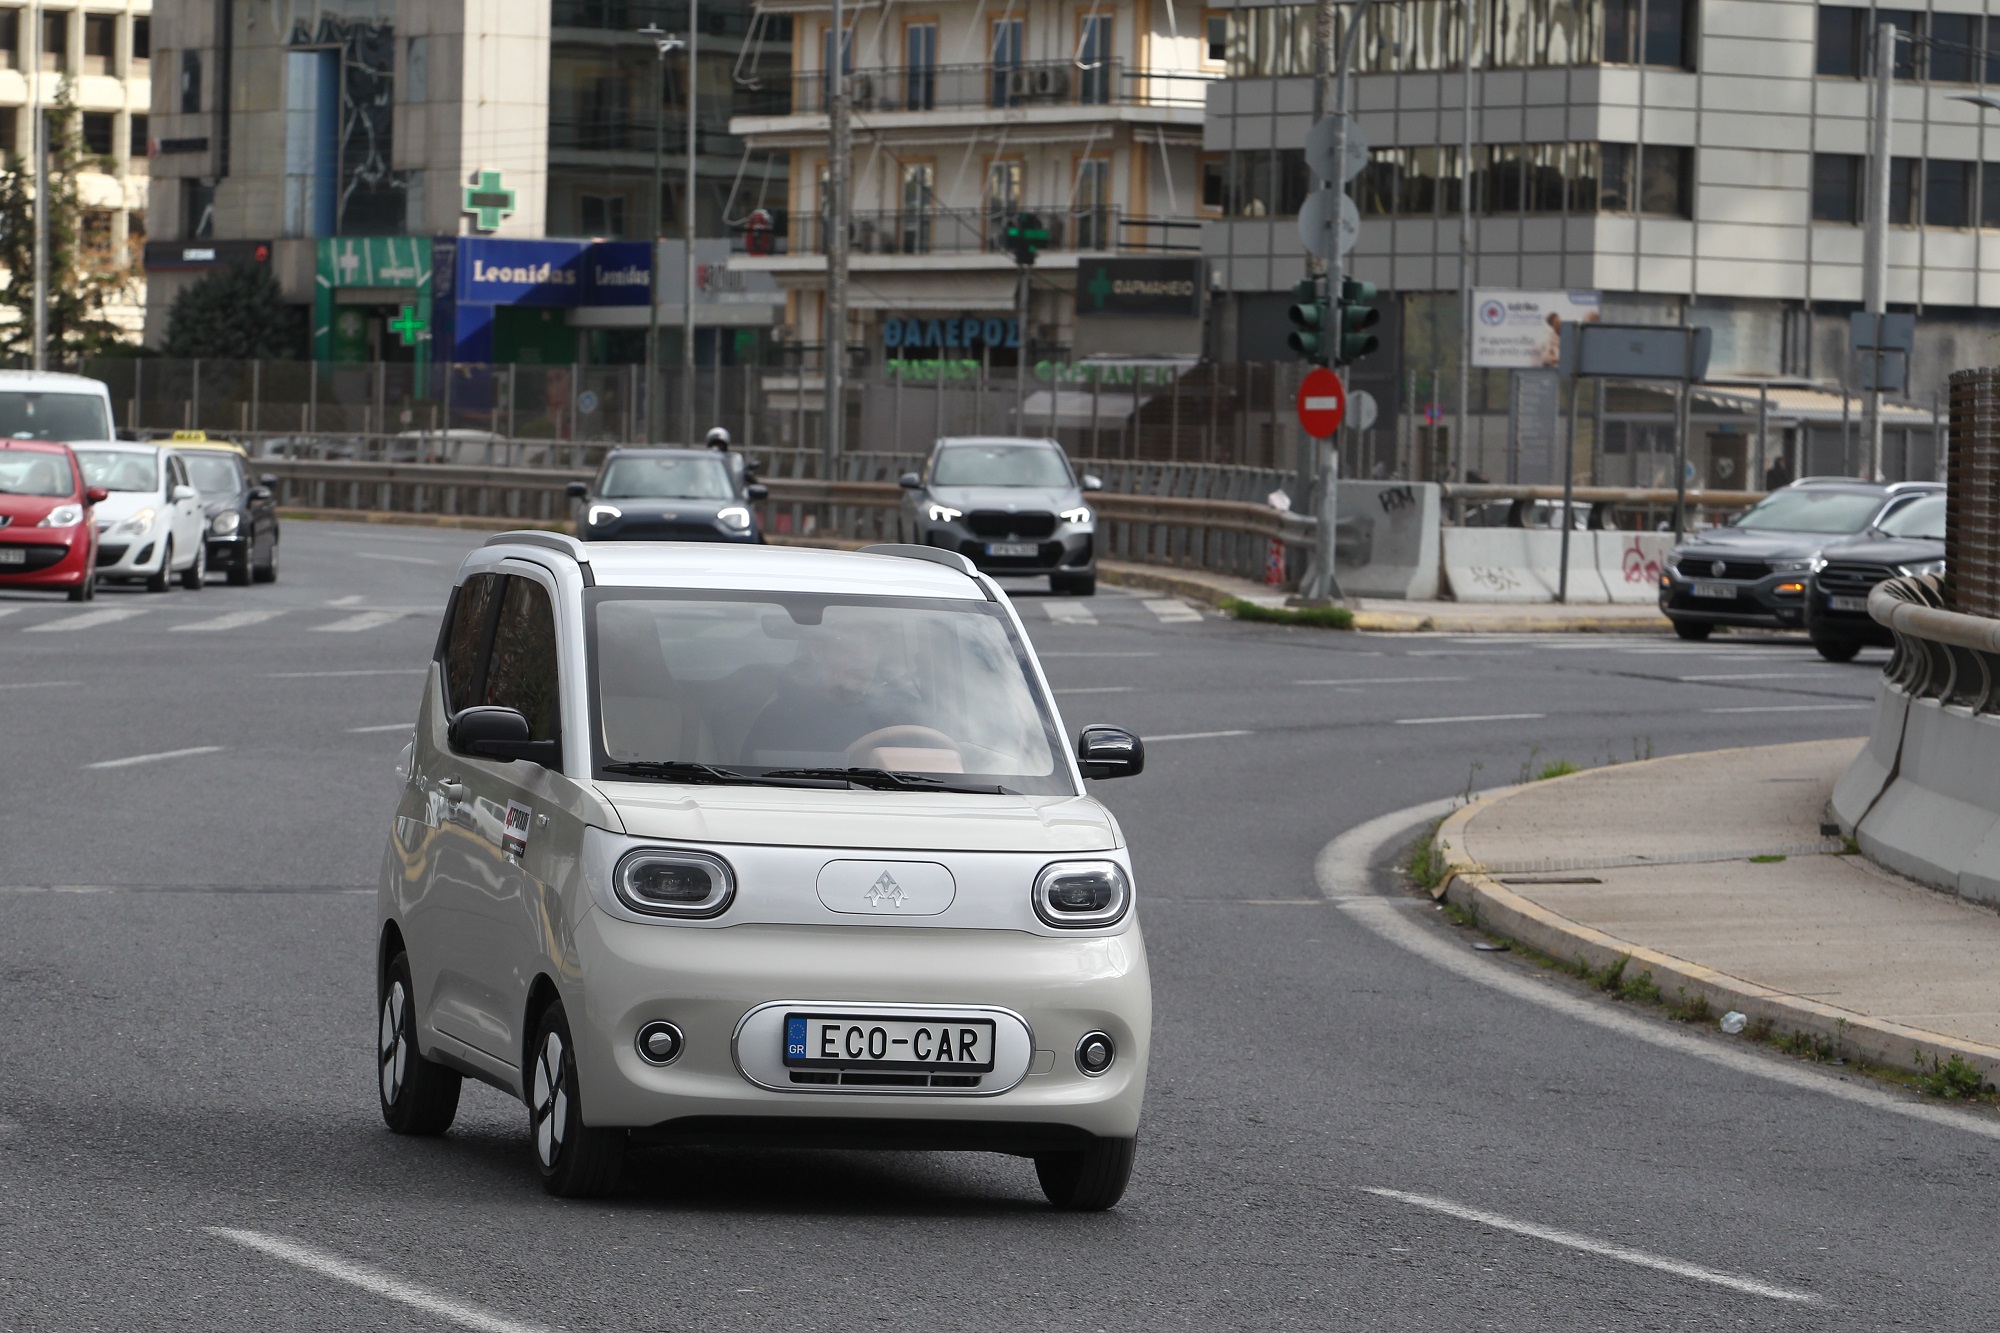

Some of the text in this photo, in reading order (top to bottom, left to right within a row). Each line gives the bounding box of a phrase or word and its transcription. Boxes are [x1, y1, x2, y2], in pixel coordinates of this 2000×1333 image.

[473, 260, 577, 285] Leonidas
[884, 317, 1021, 347] ΘΑΛΕΡΟΣ
[789, 1044, 805, 1054] GR
[821, 1024, 978, 1062] ECO-CAR
